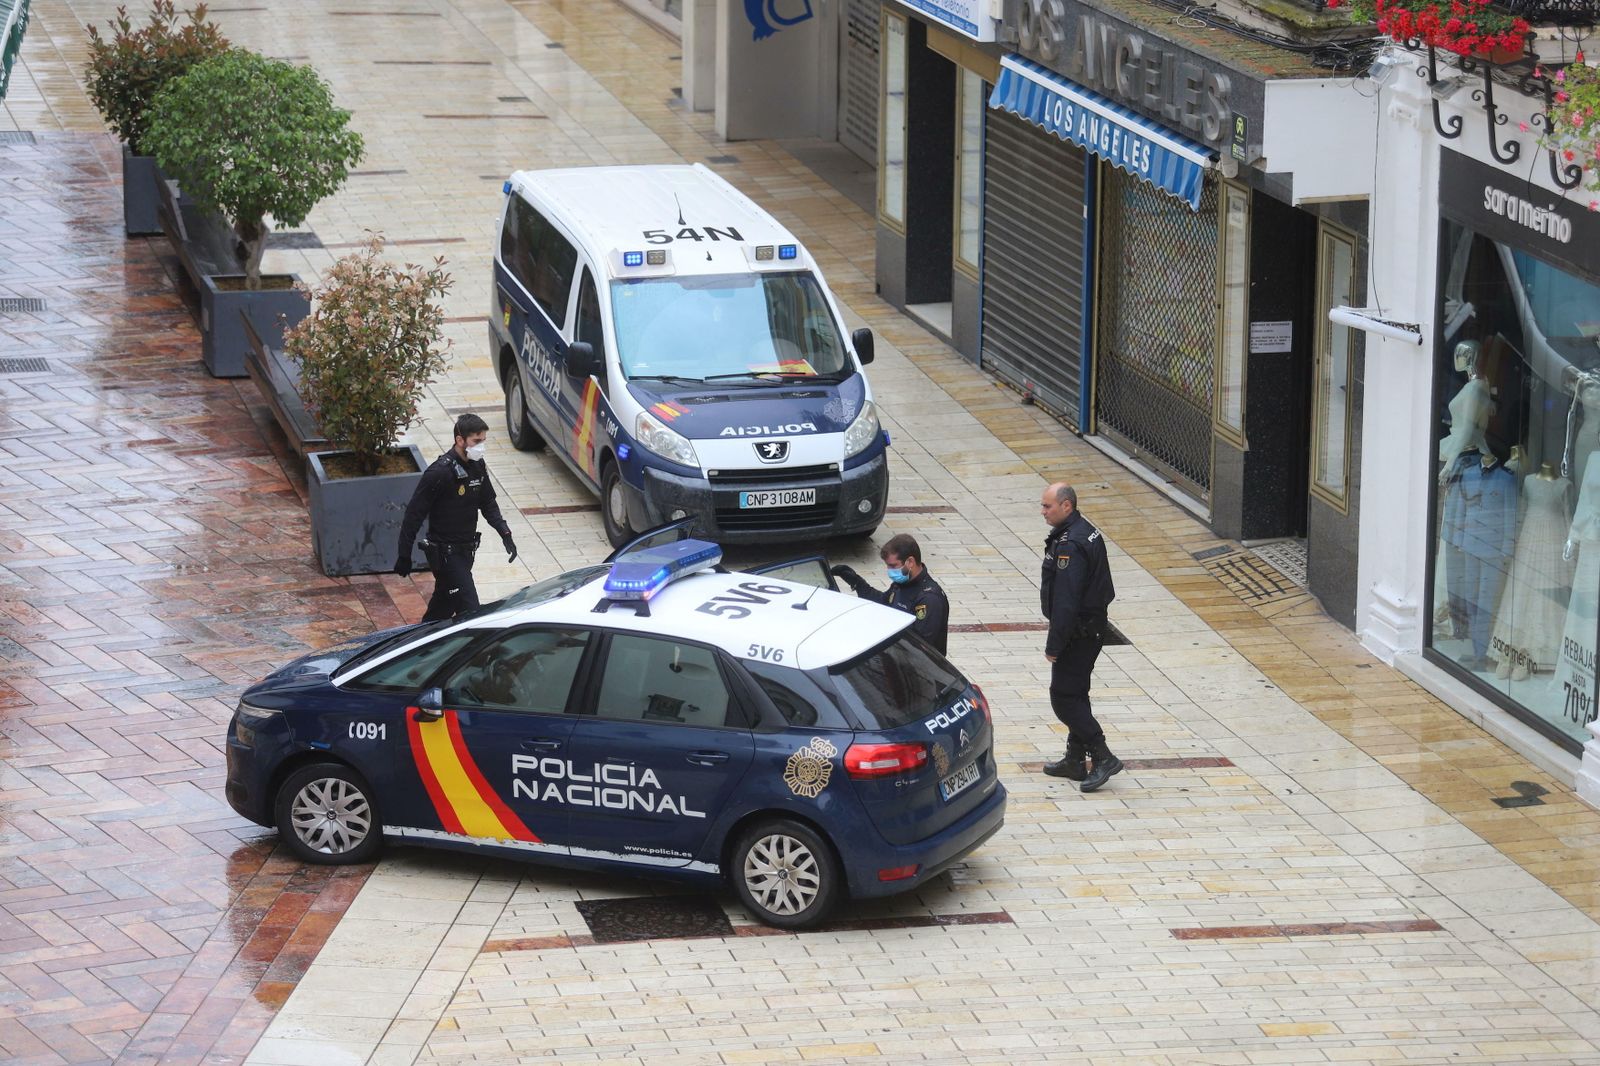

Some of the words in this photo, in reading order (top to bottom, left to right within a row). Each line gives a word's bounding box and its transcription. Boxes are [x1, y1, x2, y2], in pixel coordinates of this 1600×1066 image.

[1071, 14, 1232, 141] ANGELES
[1044, 95, 1073, 132] LOS
[1078, 113, 1151, 173] ANGELES
[642, 226, 745, 245] 54N
[520, 332, 562, 401] POLICÍA
[694, 582, 793, 620] 5V6
[747, 643, 785, 663] 5V6
[1563, 681, 1594, 729] 70%
[511, 753, 662, 790] POLICÍA
[512, 778, 706, 818] NACIONAL
[623, 844, 693, 858] www.policia.es
